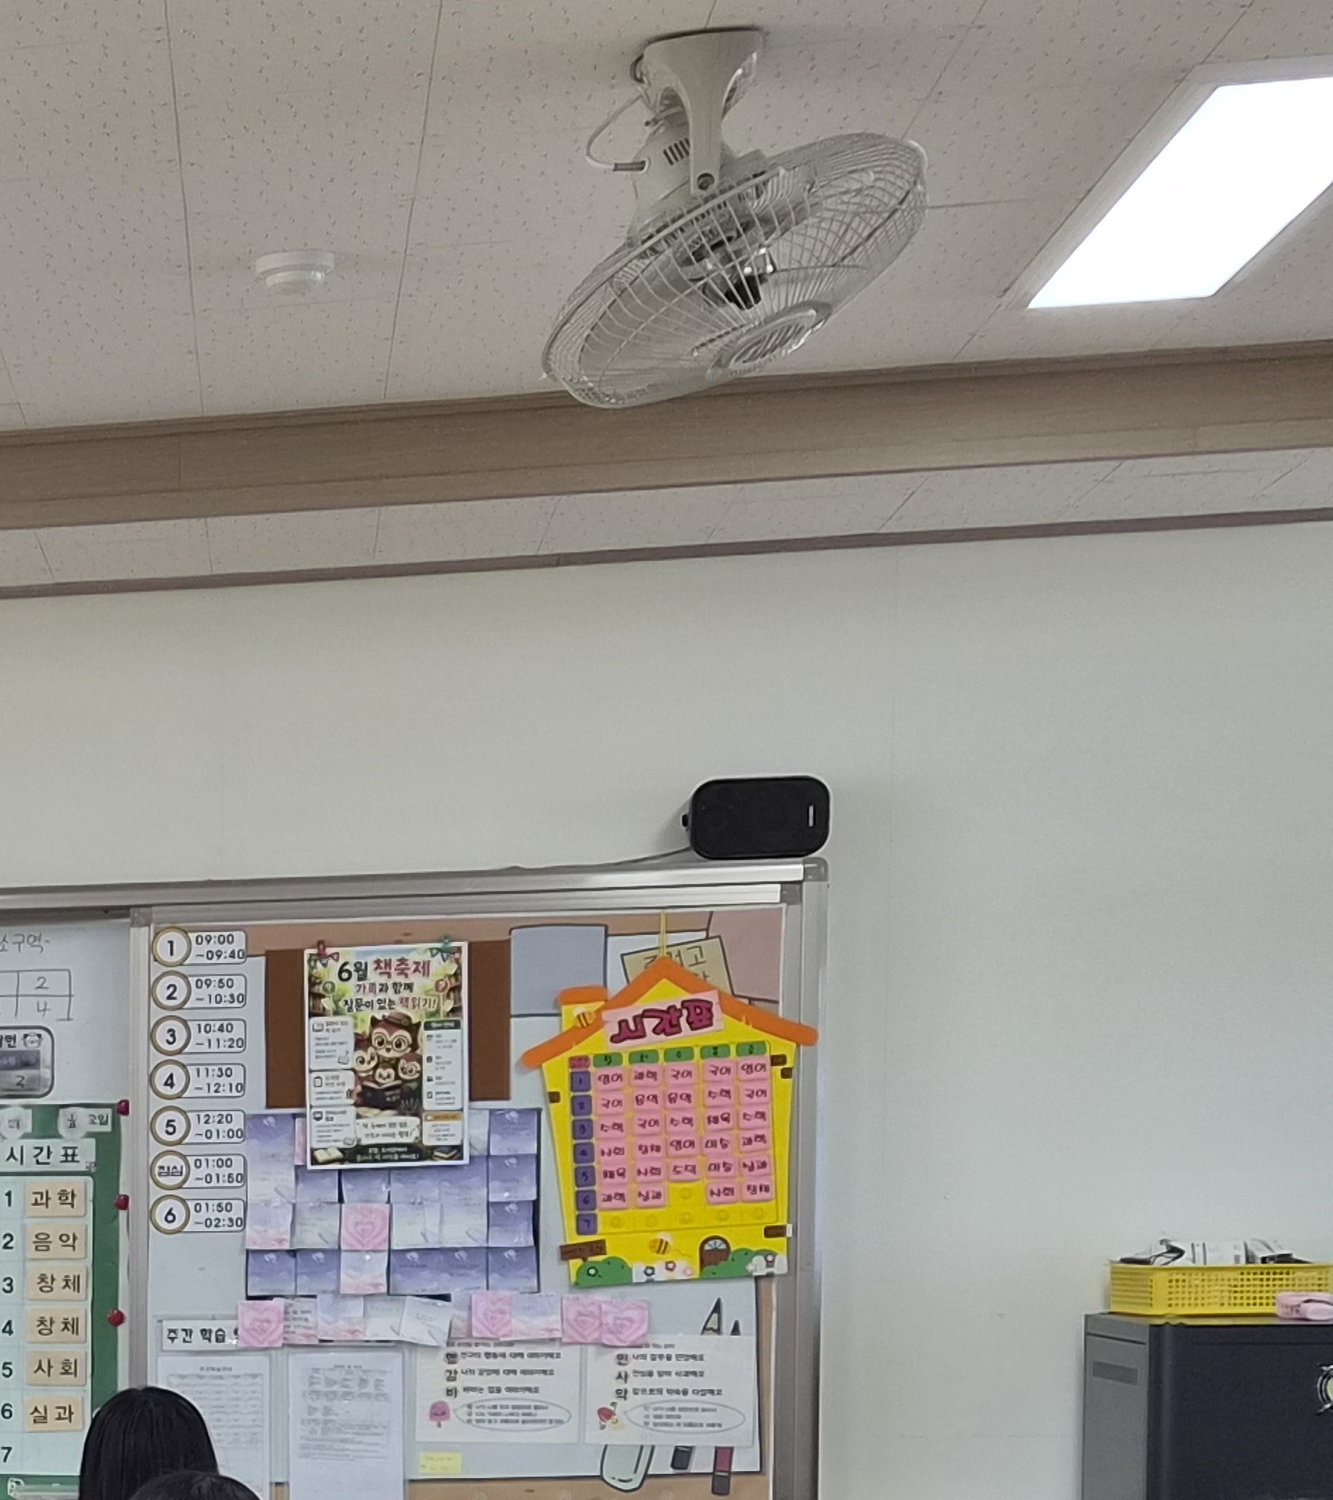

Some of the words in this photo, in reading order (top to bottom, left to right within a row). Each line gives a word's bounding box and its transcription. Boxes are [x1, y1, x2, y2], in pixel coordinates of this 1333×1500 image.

[196, 934, 235, 945] 09:00
[167, 940, 174, 957] 1
[338, 961, 368, 982] 6월
[373, 957, 432, 979] 책축제
[35, 976, 49, 990] 2
[196, 978, 234, 989] 09:50
[166, 984, 177, 1000] 2
[37, 1001, 52, 1017] 4
[197, 1023, 233, 1034] 10:40
[610, 998, 714, 1043] 시간표
[165, 1028, 176, 1045] 3
[196, 1067, 233, 1078] 11:30
[709, 1065, 731, 1076] 국어
[740, 1062, 766, 1073] 영어
[163, 1073, 175, 1089] 4
[745, 1089, 767, 1100] 국어
[165, 1119, 176, 1136] 5
[196, 1114, 233, 1125] 12:20
[637, 1118, 660, 1129] 국어
[669, 1138, 695, 1151] 영어
[6, 1145, 80, 1165] 시간표
[194, 1158, 233, 1169] 01:00
[4, 1190, 12, 1207] 1
[31, 1189, 77, 1208] 과학
[164, 1207, 176, 1224] 6
[194, 1203, 233, 1214] 01:50
[2, 1233, 14, 1250] 2
[33, 1232, 78, 1252] 음악
[2, 1277, 14, 1293] 3
[37, 1273, 80, 1293] 창체
[2, 1320, 14, 1336] 4
[36, 1317, 79, 1337] 창체
[167, 1328, 193, 1343] 주간
[2, 1361, 13, 1378] 5
[33, 1357, 78, 1378] 사회
[1, 1403, 13, 1420] 6
[29, 1404, 74, 1424] 실과
[1, 1446, 13, 1462] 7
